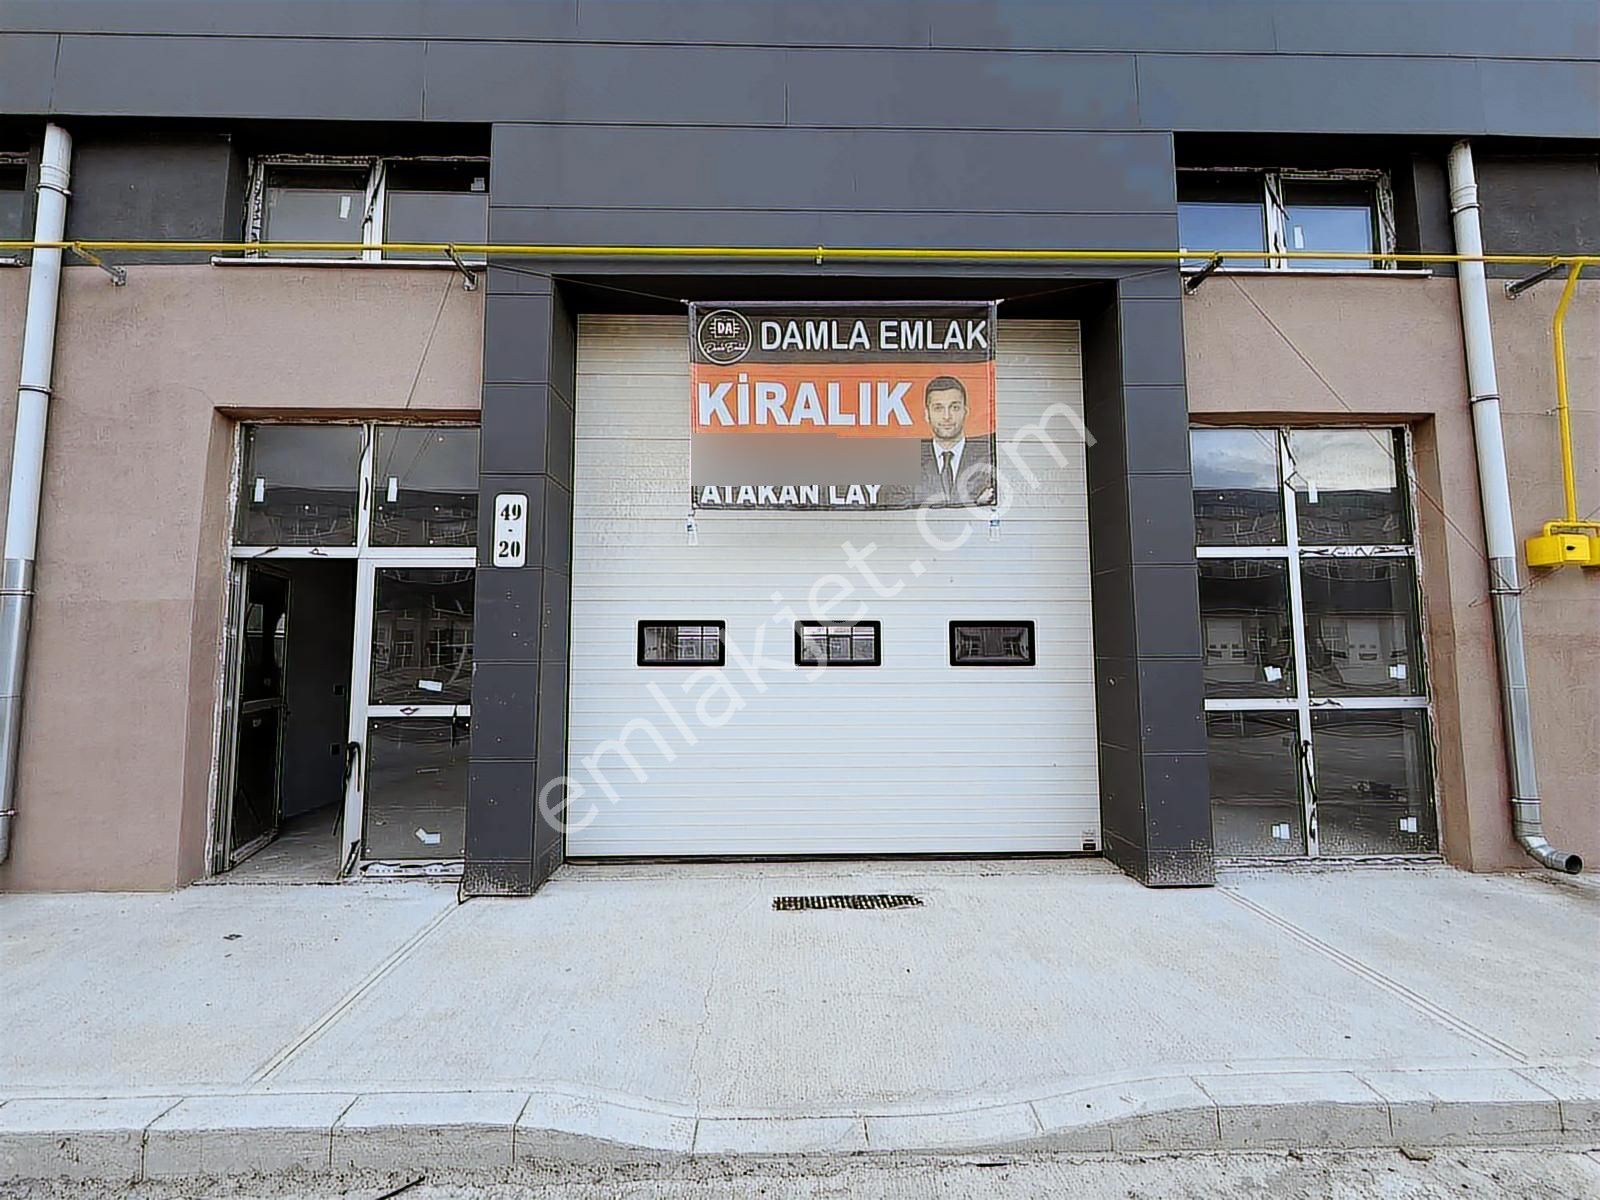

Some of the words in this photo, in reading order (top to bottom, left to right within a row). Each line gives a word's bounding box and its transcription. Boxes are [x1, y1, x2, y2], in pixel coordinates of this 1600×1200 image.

[717, 321, 733, 335] DA
[761, 320, 870, 350] DAMLA
[880, 320, 989, 350] EMLAK
[698, 373, 914, 426] KİRALIK
[701, 485, 819, 505] ATAKAN
[829, 485, 881, 505] LAY
[500, 504, 522, 521] 49
[498, 540, 521, 558] 20
